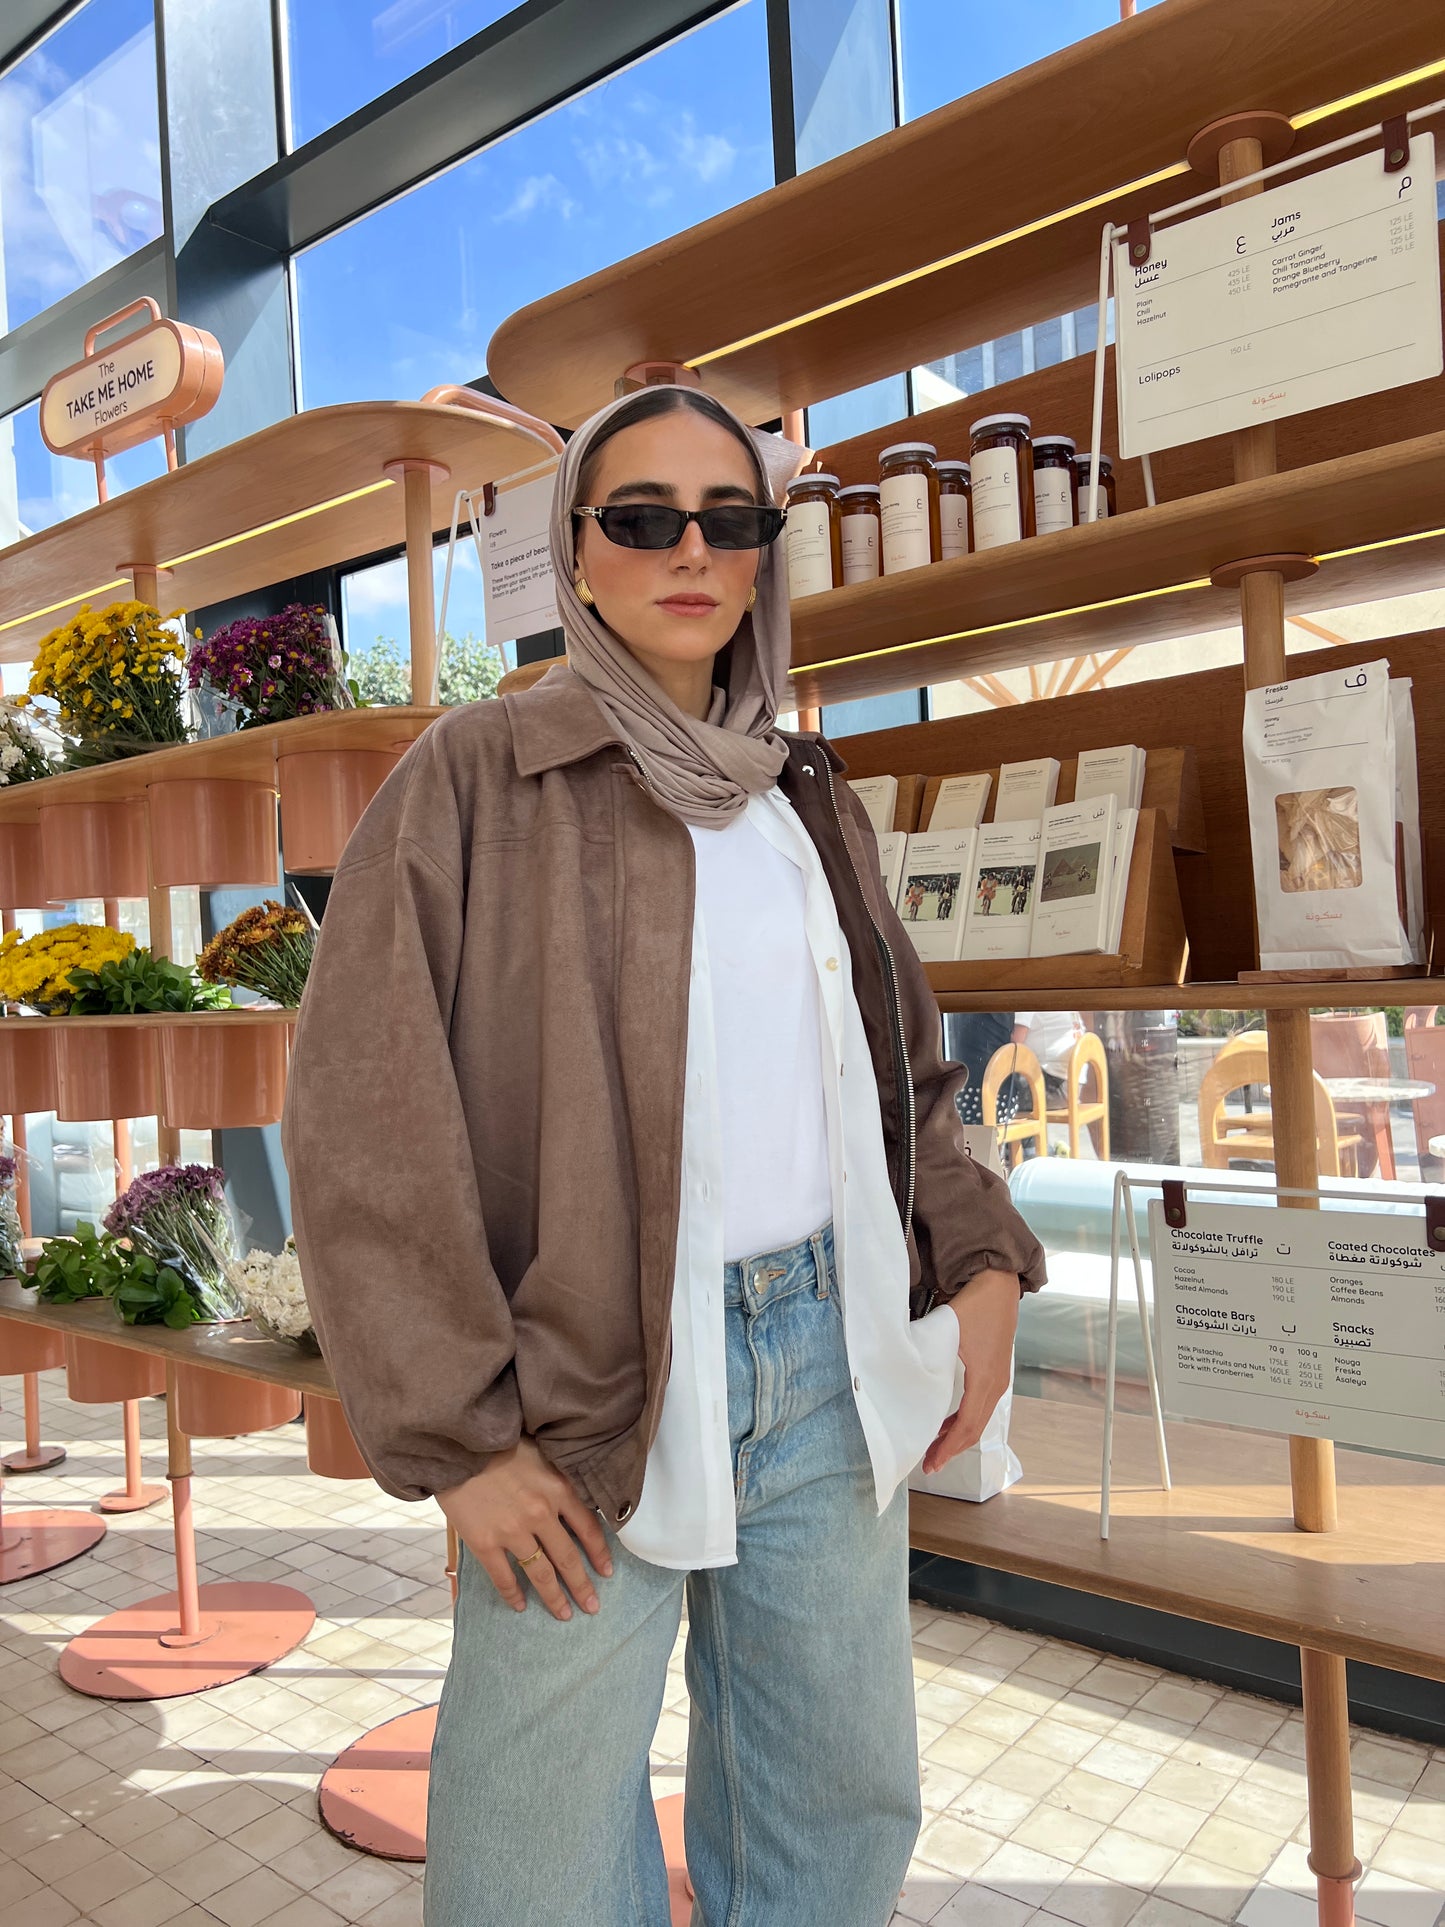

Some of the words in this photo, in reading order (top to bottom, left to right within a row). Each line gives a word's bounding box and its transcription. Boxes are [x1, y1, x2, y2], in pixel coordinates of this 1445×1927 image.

[1398, 175, 1412, 199] م
[1271, 211, 1301, 228] Jams
[1404, 212, 1413, 221] LE
[1404, 222, 1414, 231] LE
[1404, 232, 1414, 241] LE
[1236, 235, 1247, 255] ع
[1405, 241, 1414, 251] LE
[1271, 252, 1296, 266] Carrot
[1297, 244, 1323, 258] Ginger
[1135, 259, 1168, 277] Honey
[1242, 265, 1251, 273] LE
[1272, 265, 1288, 276] Chili
[1289, 253, 1326, 269] Tamarind
[1272, 270, 1300, 285] Orange
[1302, 258, 1341, 276] Blueberry
[1272, 274, 1320, 294] Pomegrante
[1321, 268, 1337, 279] and
[1339, 254, 1378, 272] Tangerine
[1134, 273, 1160, 288] عسل
[1242, 274, 1251, 283] LE
[1243, 283, 1251, 292] LE
[1136, 299, 1153, 308] Plain
[1136, 307, 1151, 317] Chili
[1136, 312, 1167, 326] Hazelnut
[1242, 343, 1252, 351] LE
[98, 361, 115, 378] The
[1138, 366, 1181, 385] Lolipops
[66, 390, 96, 419] TAKE
[98, 380, 116, 404] ME
[117, 360, 155, 394] HOME
[94, 401, 128, 426] Flowers
[491, 561, 504, 570] Take
[510, 554, 525, 565] piece
[526, 550, 532, 558] of
[1344, 667, 1367, 688] ف
[1265, 684, 1289, 695] Freska
[1171, 1229, 1223, 1242] Chocolate
[1226, 1233, 1264, 1245] Truffle
[1172, 1241, 1228, 1257] بالشوكولاتة
[1231, 1247, 1258, 1259] ترافل
[1276, 1243, 1291, 1255] ت
[1328, 1240, 1368, 1253] Coated
[1371, 1243, 1436, 1258] Chocolates
[1329, 1252, 1366, 1263] مغطاة
[1369, 1254, 1422, 1269] شوكولاتة
[1173, 1266, 1196, 1275] Cocoa
[1174, 1275, 1205, 1284] Hazelnut
[1285, 1277, 1294, 1285] LE
[1329, 1276, 1364, 1286] Oranges
[1174, 1283, 1197, 1292] Salted
[1198, 1286, 1229, 1296] Almonds
[1272, 1285, 1284, 1293] 190
[1286, 1286, 1295, 1294] LE
[1330, 1286, 1357, 1295] Coffee
[1359, 1288, 1384, 1297] Beans
[1273, 1294, 1285, 1302] 190
[1287, 1295, 1295, 1303] LE
[1331, 1295, 1365, 1305] Almonds
[1175, 1304, 1228, 1319] Chocolate
[1230, 1311, 1256, 1322] Bars
[1176, 1316, 1229, 1331] الشوكولاتة
[1332, 1322, 1375, 1335] Snacks
[1231, 1324, 1257, 1336] بارات
[1281, 1324, 1297, 1336] ب
[1334, 1334, 1371, 1348] تصبيرة
[1177, 1345, 1191, 1353] Milk
[1192, 1347, 1224, 1357] Pistachio
[1297, 1348, 1310, 1356] 100
[1178, 1353, 1195, 1361] Dark
[1196, 1356, 1211, 1364] with
[1212, 1358, 1232, 1367] Fruits
[1233, 1361, 1248, 1369] and
[1249, 1363, 1266, 1372] Nuts
[1313, 1363, 1322, 1371] LE
[1334, 1357, 1361, 1367] Nouga
[1178, 1362, 1195, 1370] Dark
[1196, 1365, 1211, 1373] with
[1212, 1367, 1254, 1379] Cranberries
[1314, 1372, 1323, 1380] LE
[1335, 1366, 1362, 1376] Freska
[1283, 1377, 1292, 1385] LE
[1314, 1381, 1323, 1389] LE
[1335, 1376, 1367, 1387] Asaleya
